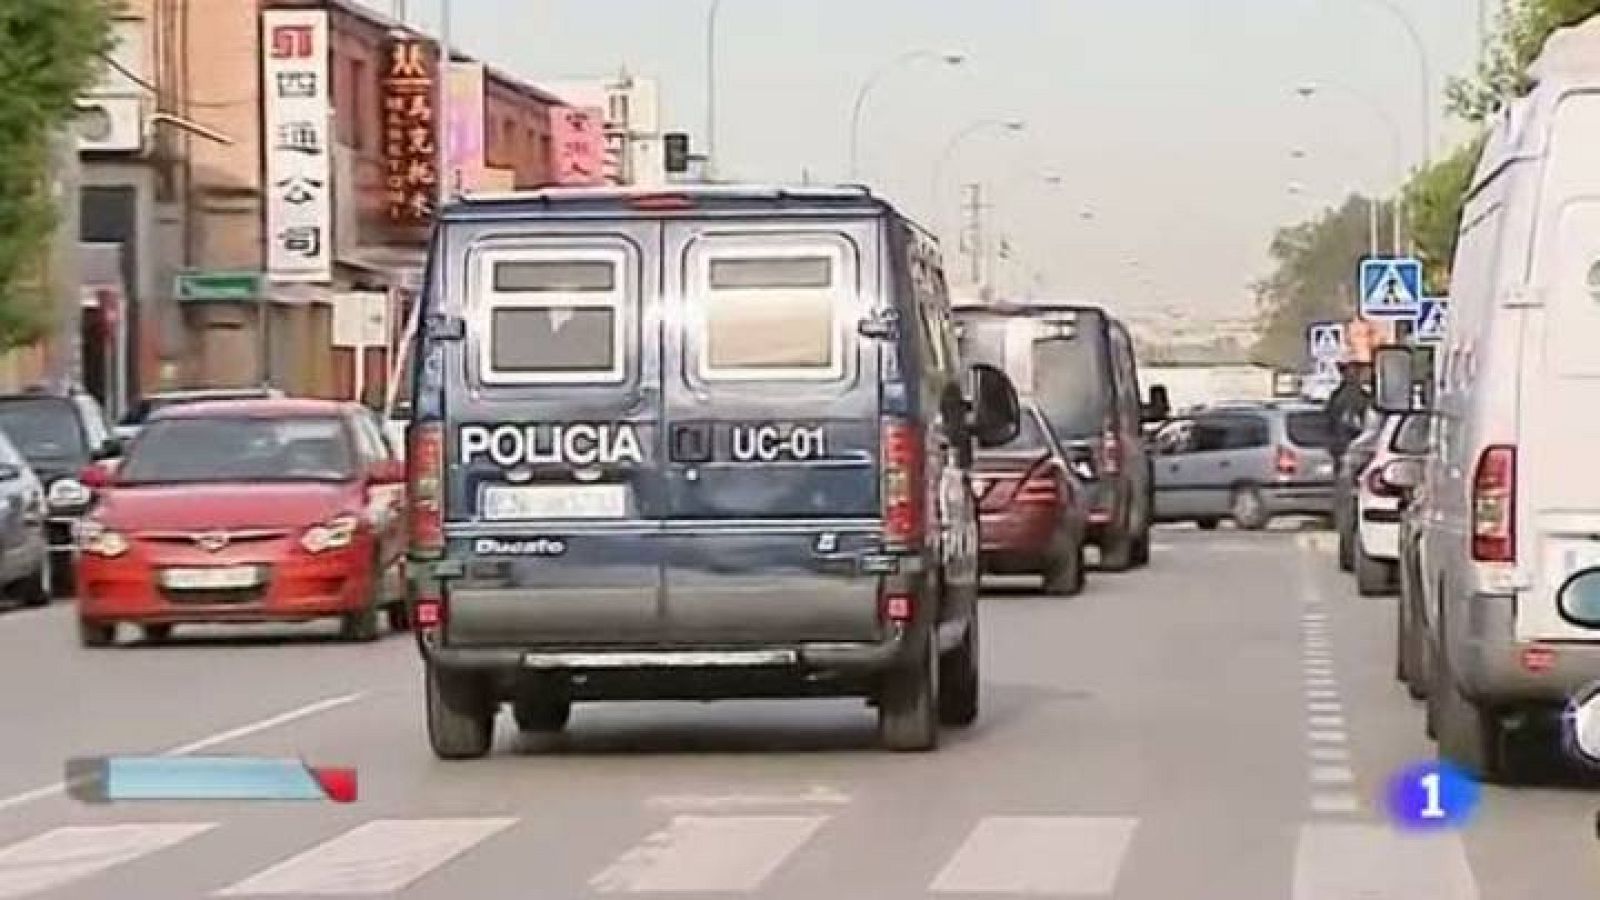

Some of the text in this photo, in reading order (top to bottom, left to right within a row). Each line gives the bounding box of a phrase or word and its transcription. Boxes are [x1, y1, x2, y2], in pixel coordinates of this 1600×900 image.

[273, 70, 323, 258] 四通公司
[460, 423, 643, 466] POLICIA
[732, 426, 825, 461] UC-01
